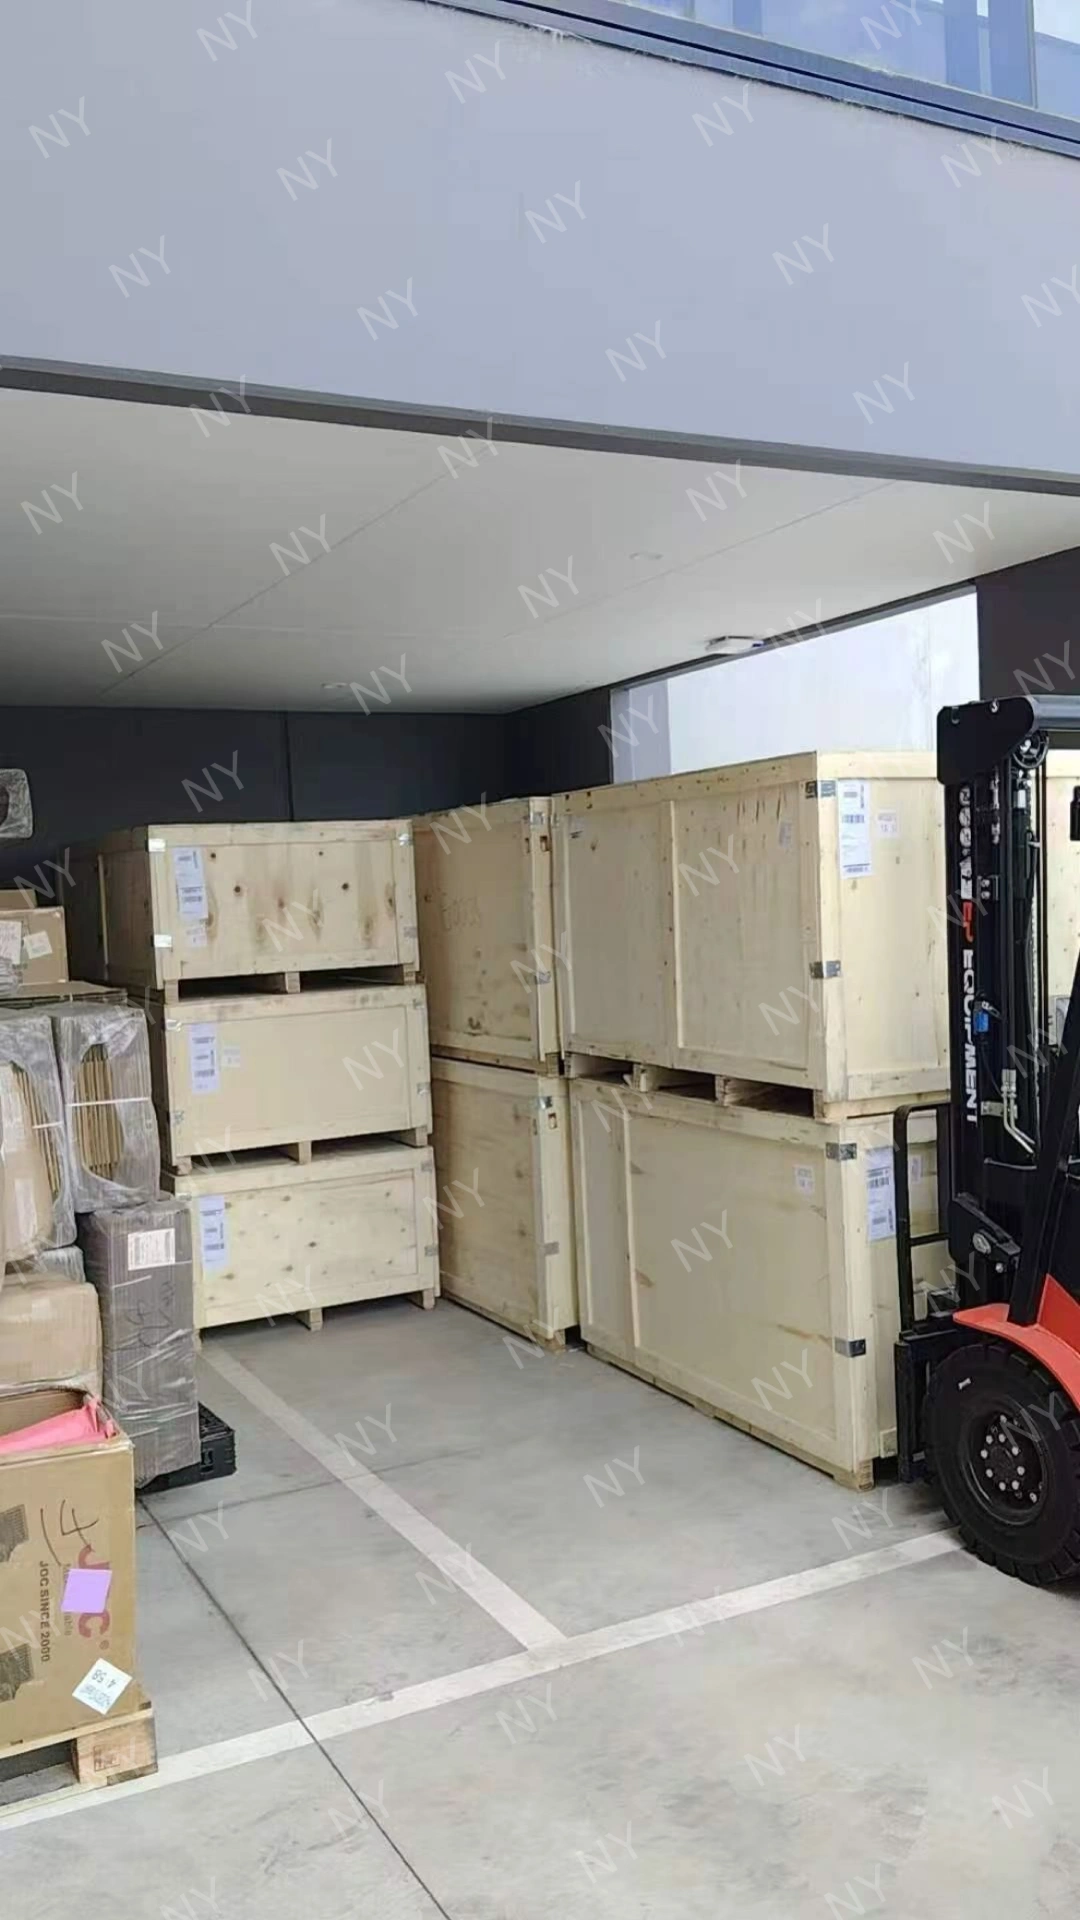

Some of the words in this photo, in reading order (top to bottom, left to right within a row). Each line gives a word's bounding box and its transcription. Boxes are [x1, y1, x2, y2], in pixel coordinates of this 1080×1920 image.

[962, 949, 978, 1128] EQUIPMENT
[39, 1589, 50, 1629] SINCE
[77, 1544, 111, 1638] JC
[40, 1631, 51, 1663] 2000
